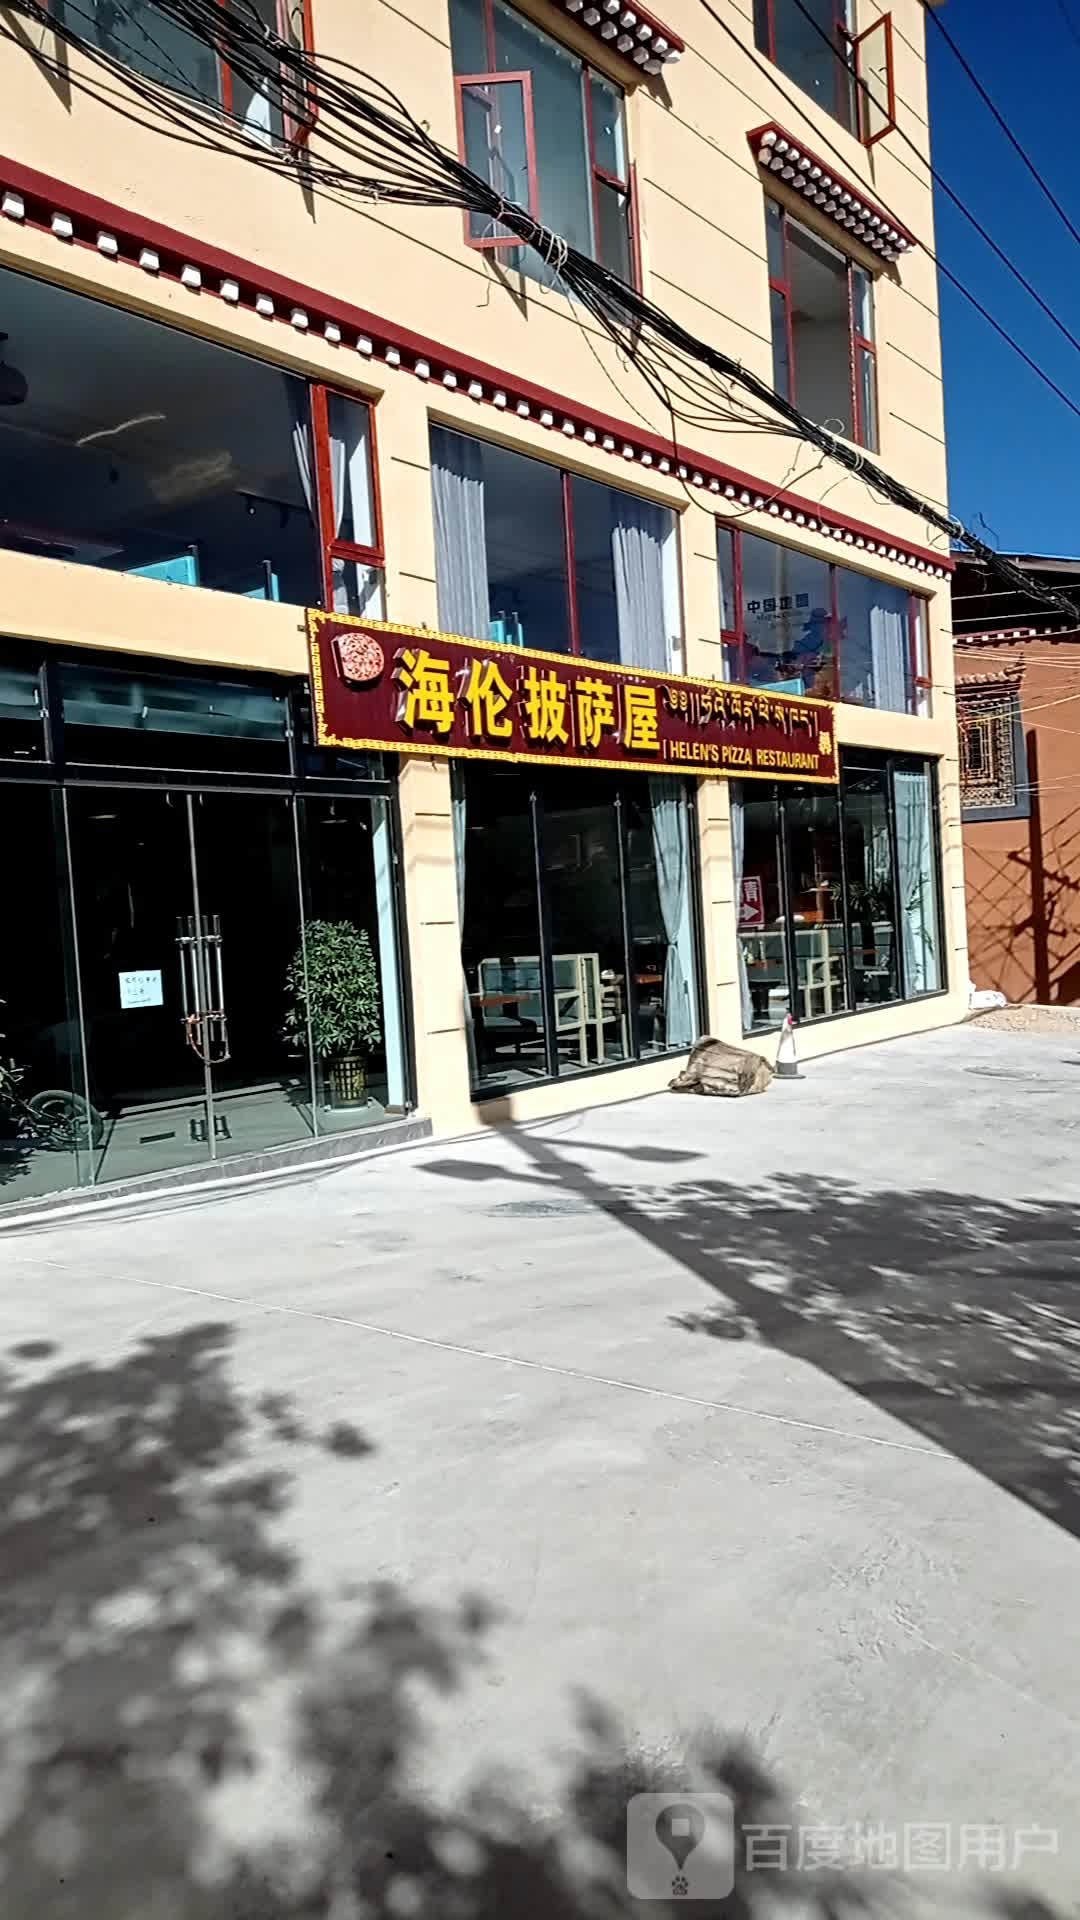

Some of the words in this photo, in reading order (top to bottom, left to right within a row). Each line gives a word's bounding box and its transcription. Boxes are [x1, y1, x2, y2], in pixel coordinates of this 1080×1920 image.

[398, 648, 660, 751] 海伦披萨屋
[669, 740, 719, 761] HELEN'S
[721, 745, 753, 765] PIZZA
[756, 749, 820, 769] RESTAURANT
